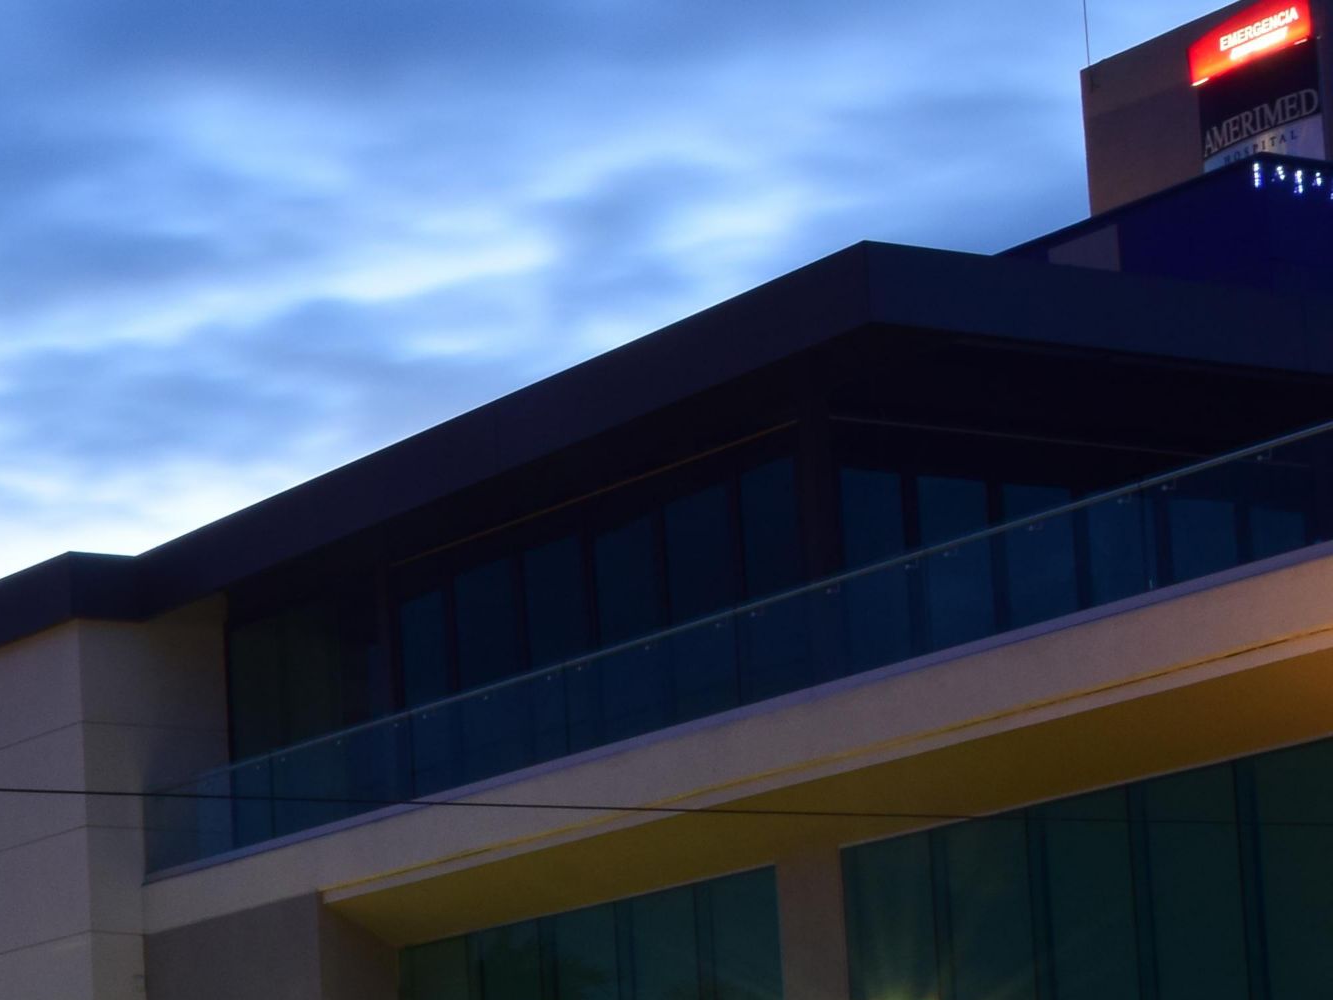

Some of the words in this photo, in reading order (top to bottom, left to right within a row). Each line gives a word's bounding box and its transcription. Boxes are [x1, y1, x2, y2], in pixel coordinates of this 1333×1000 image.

[1219, 6, 1299, 52] EMERGENCIA
[1203, 88, 1320, 158] AMERIMED
[1223, 130, 1299, 164] HOSPITAL
